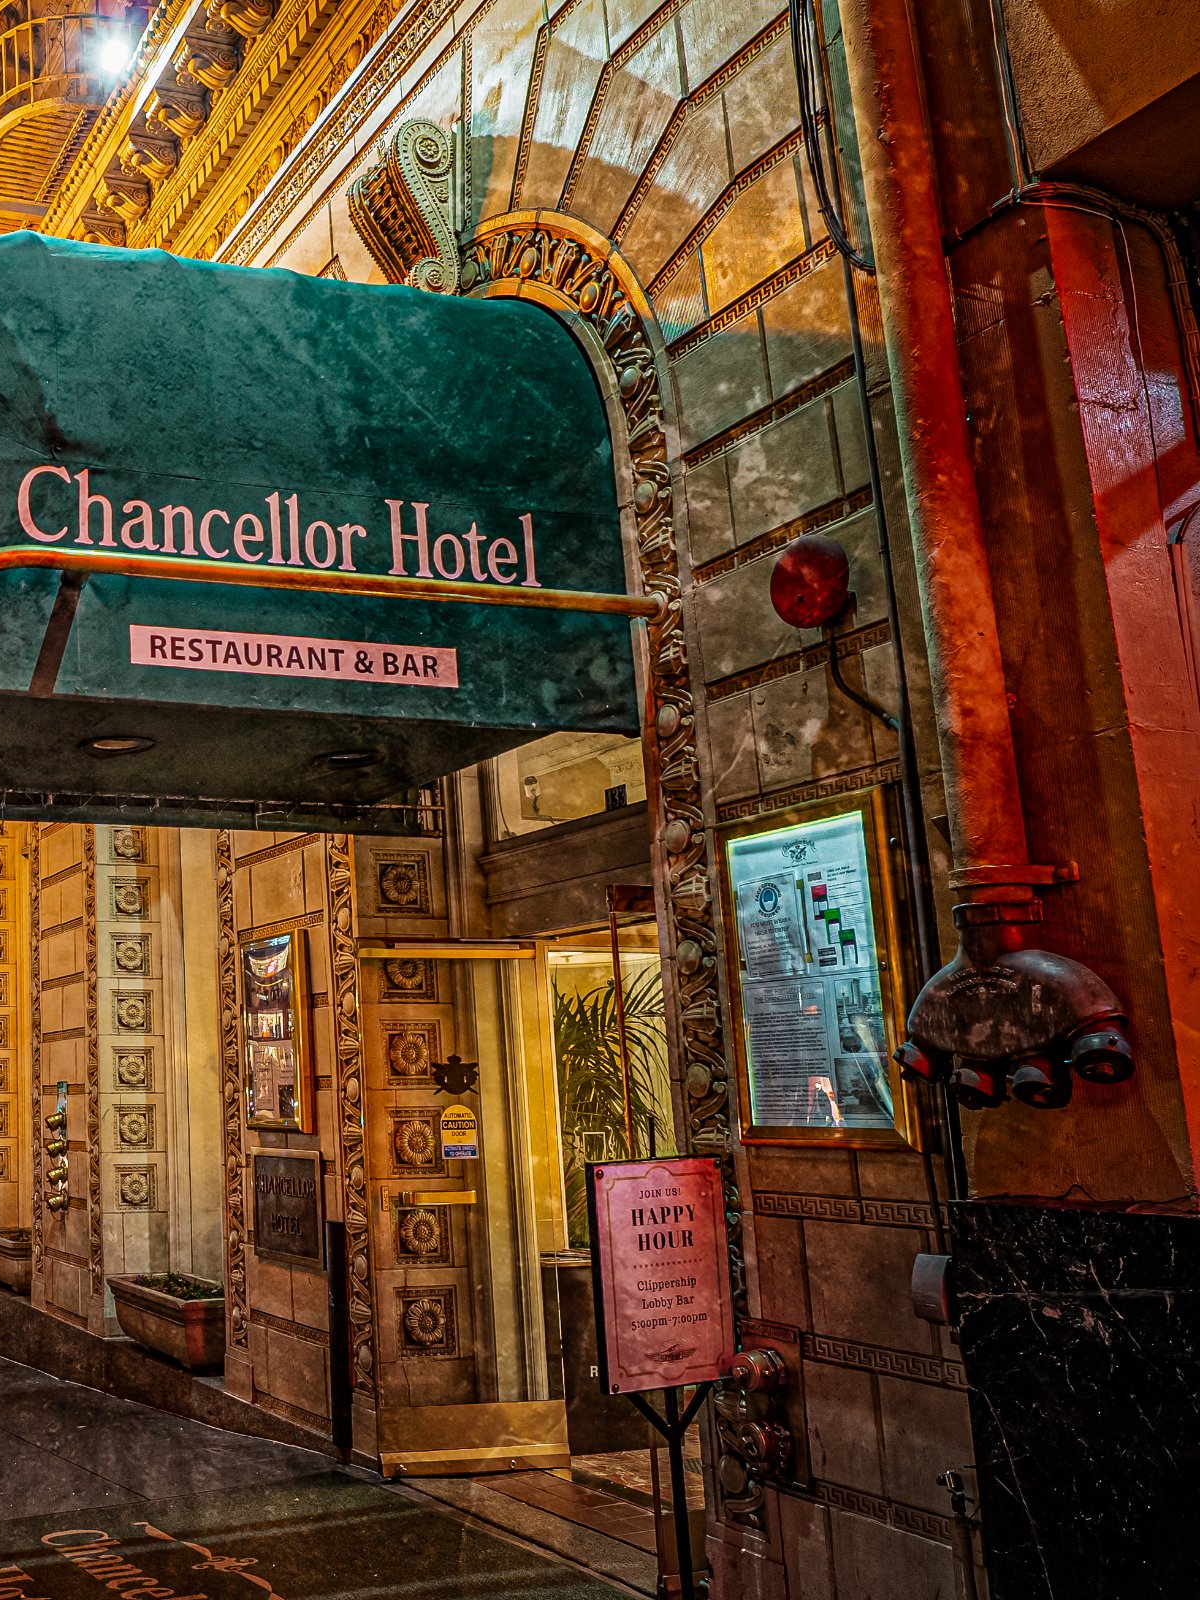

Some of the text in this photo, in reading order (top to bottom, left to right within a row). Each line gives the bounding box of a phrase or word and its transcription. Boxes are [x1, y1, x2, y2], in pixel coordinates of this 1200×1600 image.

[17, 464, 542, 588] Chancellor Hotel
[149, 634, 439, 678] RESTAURANT & BAR
[442, 1120, 475, 1129] CAUTION
[255, 1175, 316, 1199] CHANCELLOR
[638, 1187, 682, 1199] JOIN US!
[271, 1213, 303, 1236] HOTEL
[631, 1204, 696, 1227] HAPPY
[637, 1229, 694, 1251] HOUR
[636, 1275, 697, 1293] Clippership
[641, 1295, 695, 1310] Lobby Bar
[589, 1366, 599, 1377] R
